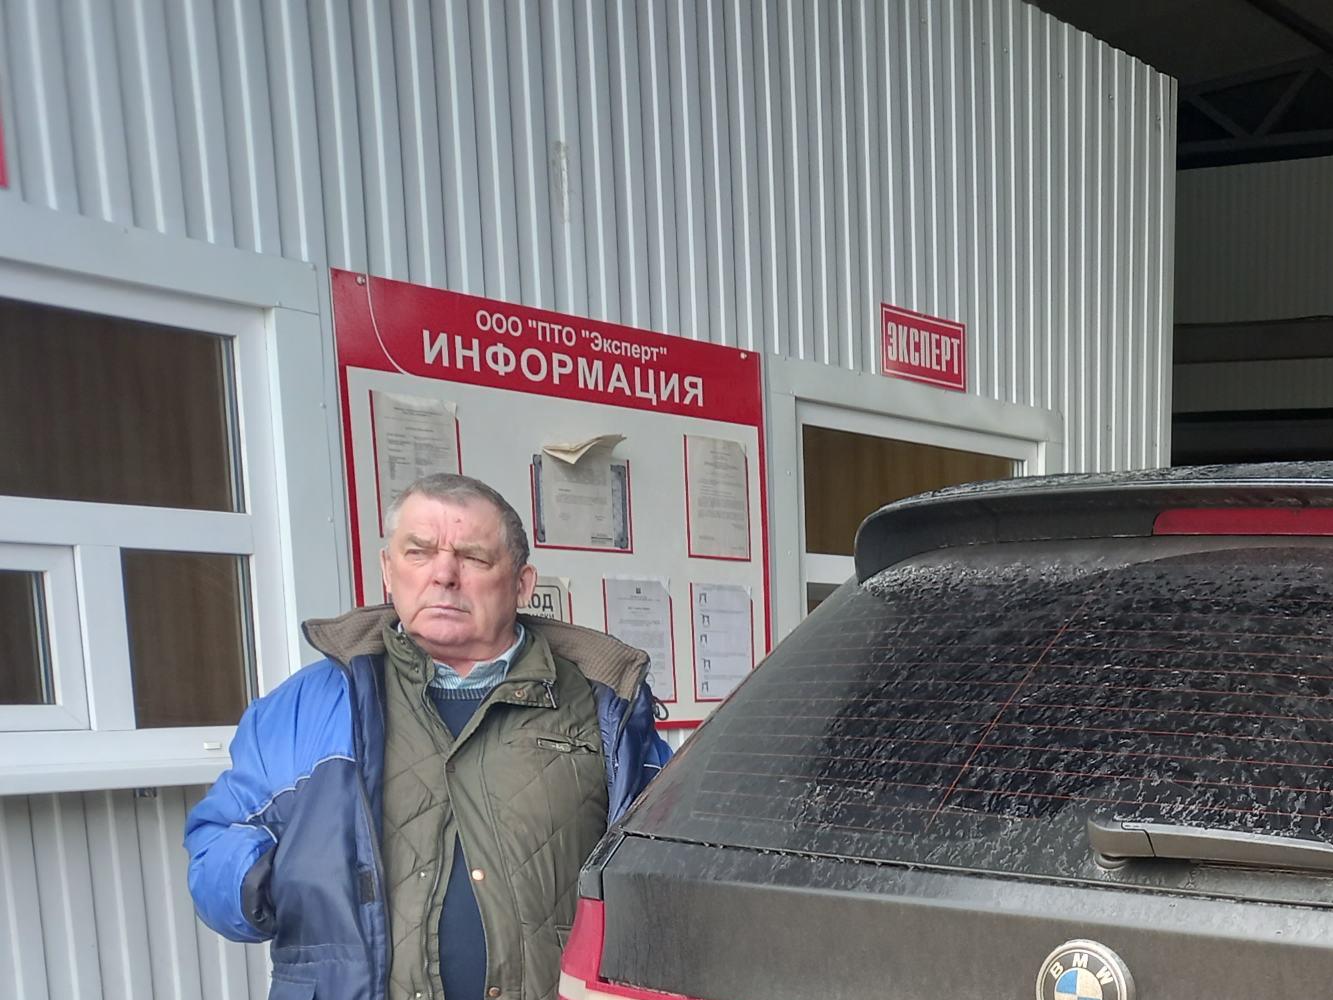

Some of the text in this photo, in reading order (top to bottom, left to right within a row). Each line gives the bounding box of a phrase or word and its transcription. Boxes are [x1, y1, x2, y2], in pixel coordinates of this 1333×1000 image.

[475, 309, 668, 363] ООО "ПТО "Эксперт"
[887, 321, 960, 375] ЭКСПЕРТ
[422, 329, 704, 407] ИНФОРМАЦИЯ
[528, 593, 553, 612] ОД
[1049, 952, 1114, 985] BMW
